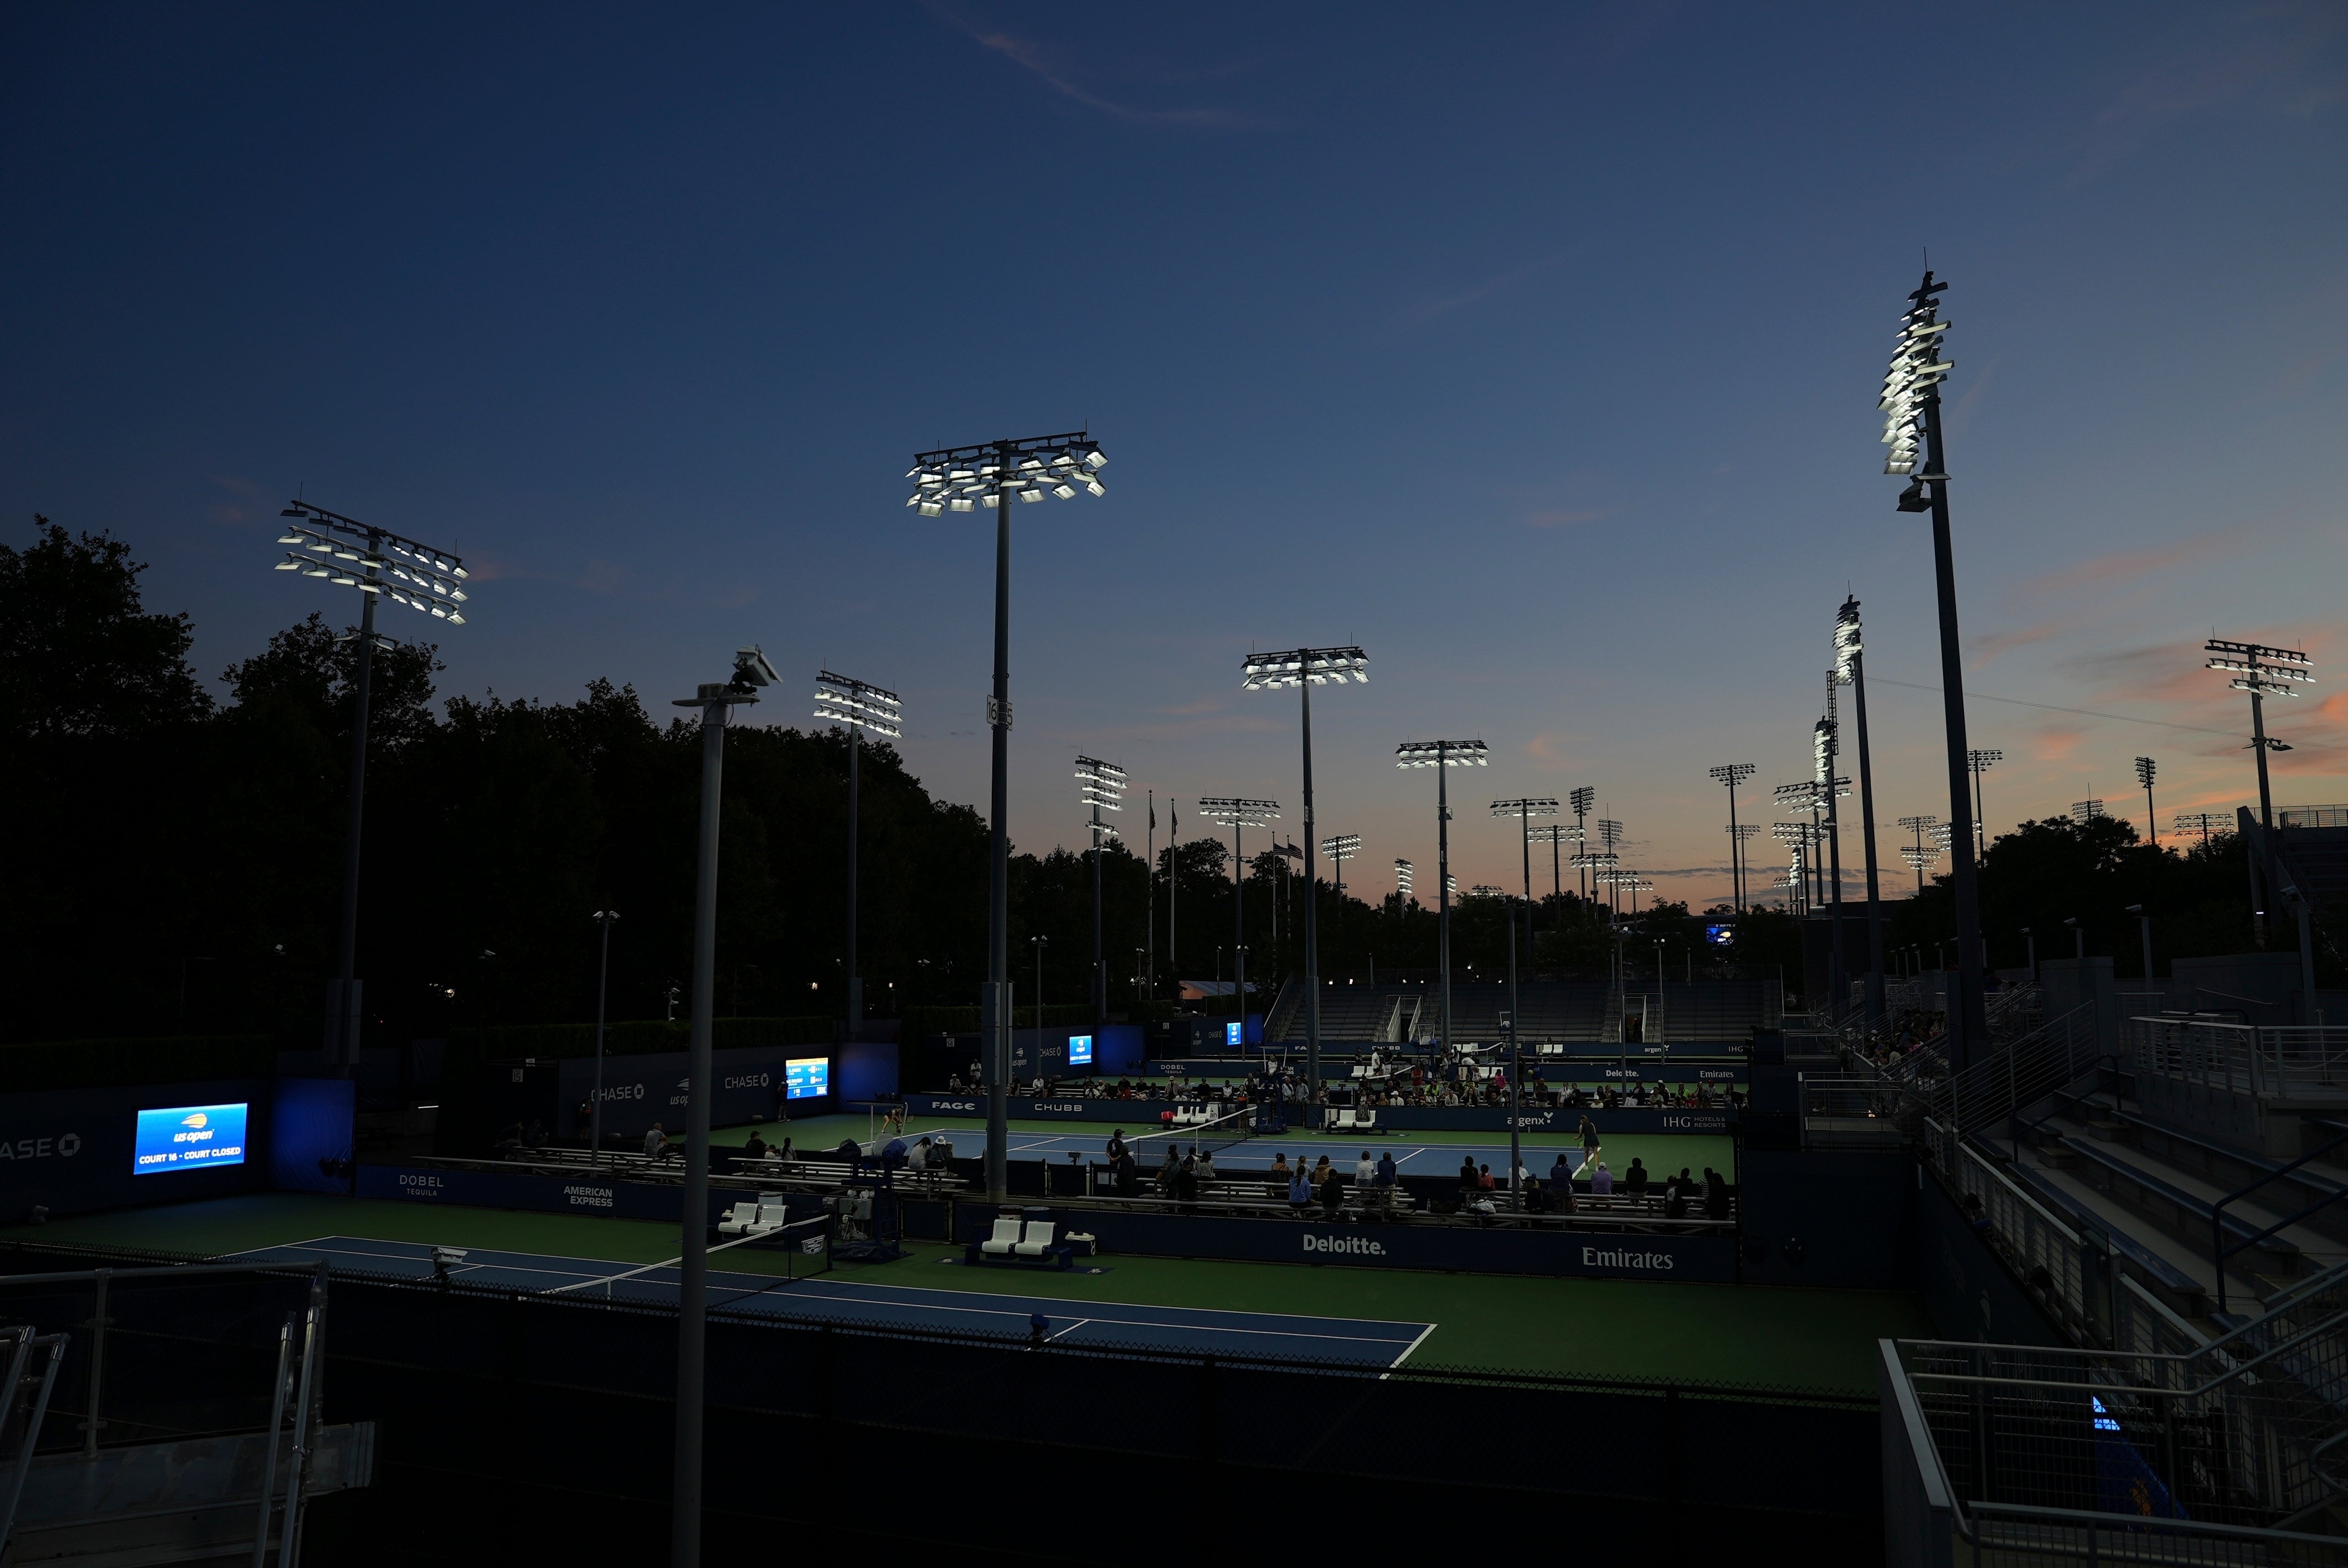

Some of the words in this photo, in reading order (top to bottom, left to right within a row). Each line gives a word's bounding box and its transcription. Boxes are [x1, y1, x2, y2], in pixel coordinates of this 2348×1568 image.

[988, 701, 997, 720] 16
[1007, 708, 1012, 725] 5
[514, 1073, 521, 1081] 15
[1700, 1070, 1734, 1079] Emirates
[725, 1075, 759, 1089] CHASE
[1034, 1103, 1083, 1112] CHUBB
[1507, 1117, 1545, 1127] agenx
[1664, 1116, 1691, 1127] IHG
[0, 1137, 54, 1160] ASE
[139, 1154, 167, 1164] COURT
[168, 1153, 177, 1162] 16
[184, 1149, 210, 1160] COURT
[212, 1147, 241, 1157] CLOSED
[399, 1174, 444, 1188] DOBEL
[406, 1188, 437, 1196] TEQUILA
[563, 1185, 612, 1198] AMERICAN
[570, 1196, 613, 1207] EXPRESS
[1303, 1234, 1386, 1255] Deloitte.
[1582, 1246, 1674, 1270] Emirates
